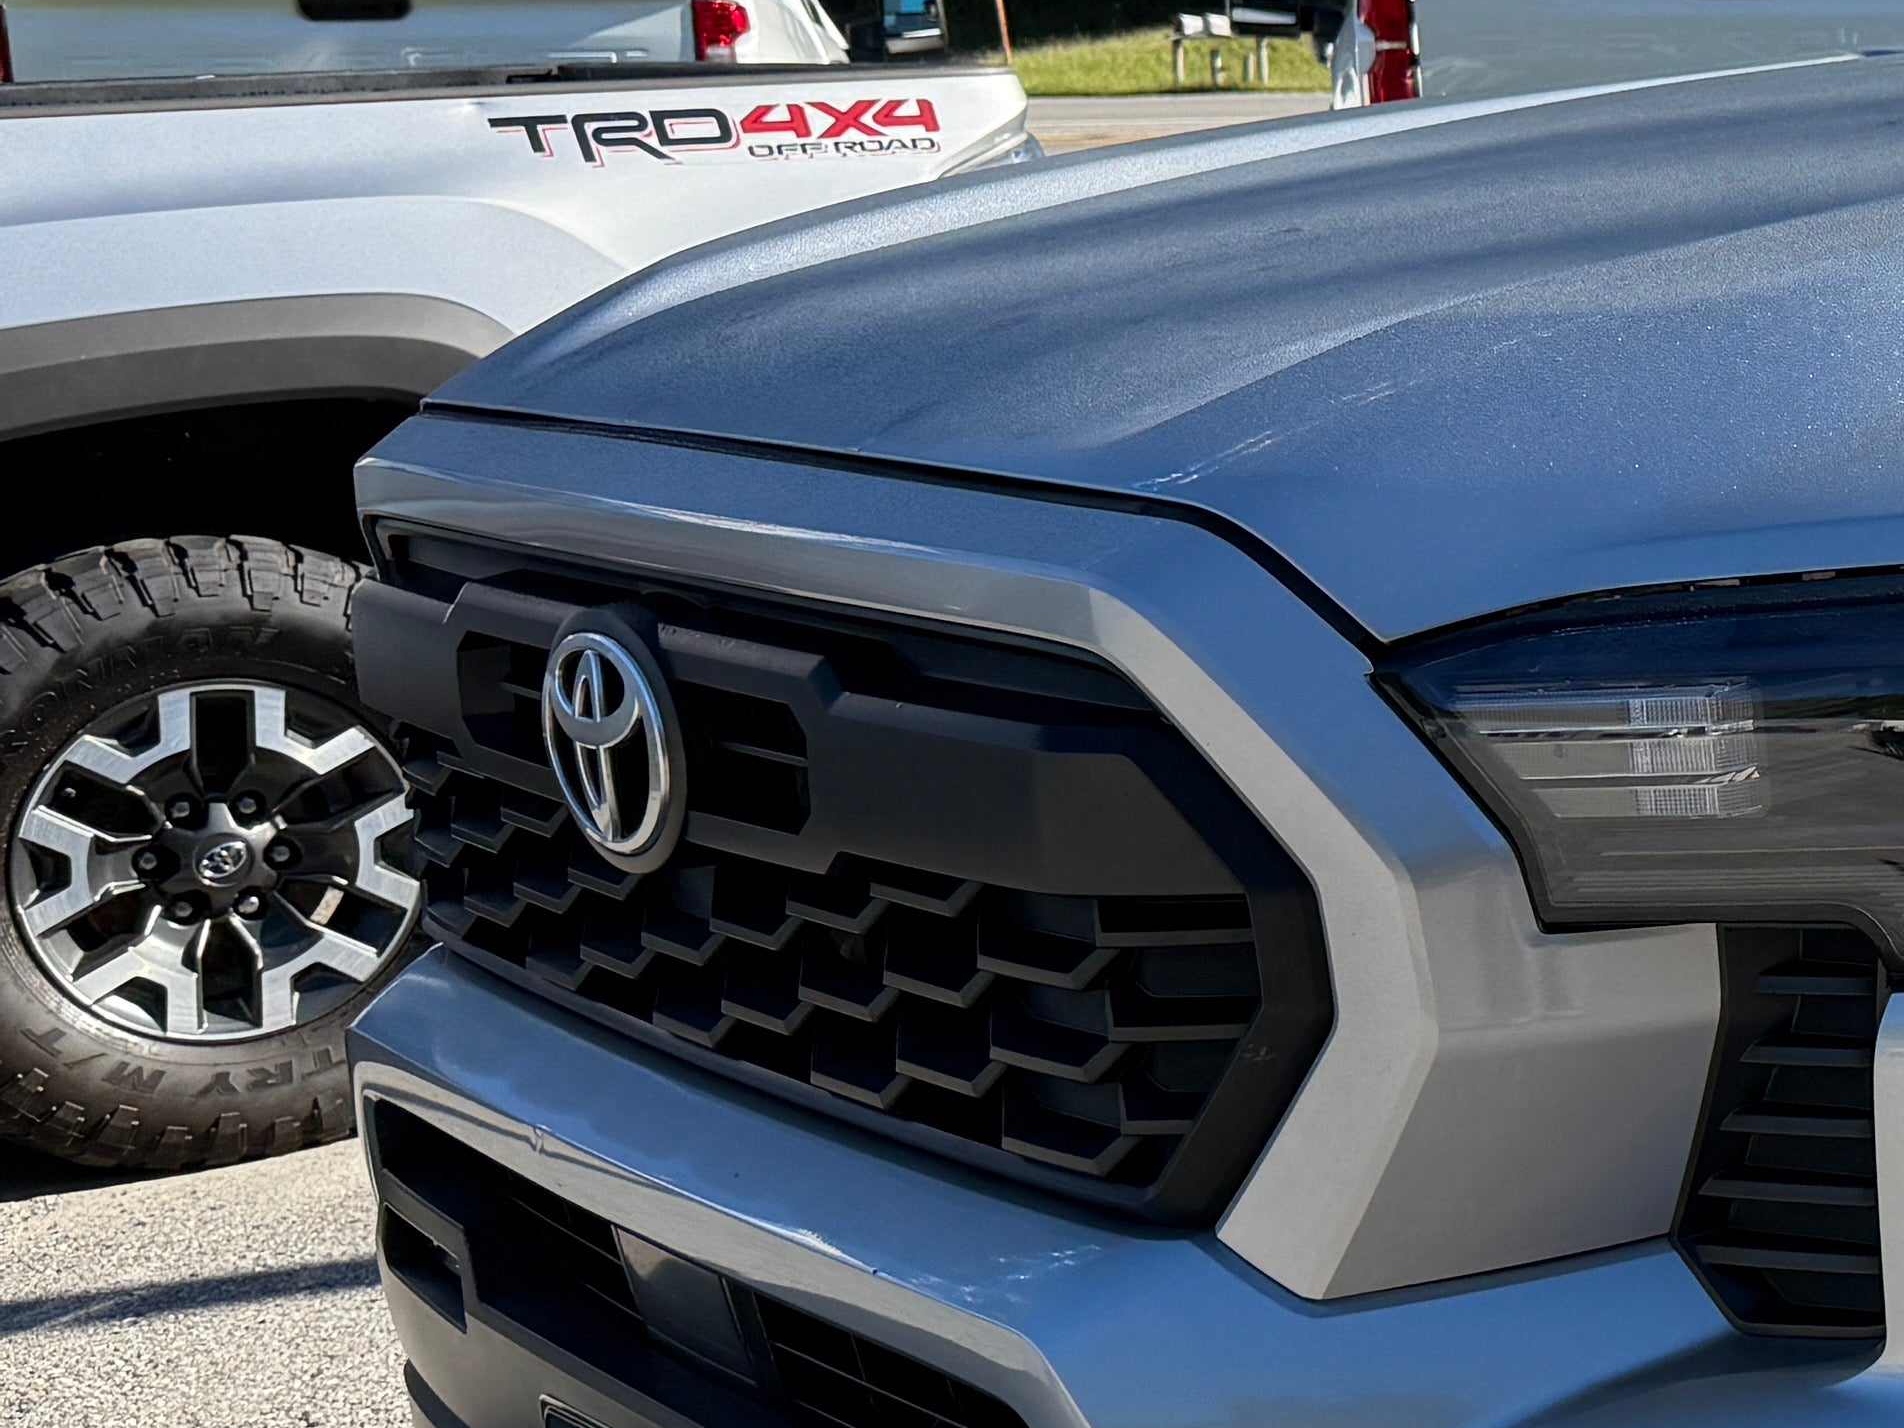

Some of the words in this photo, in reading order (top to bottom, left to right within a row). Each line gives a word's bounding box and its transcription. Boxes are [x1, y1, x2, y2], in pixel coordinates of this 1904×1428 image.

[487, 107, 742, 168] TRD
[739, 98, 941, 140] 4X4
[748, 142, 828, 161] OFF
[834, 136, 942, 157] ROAD
